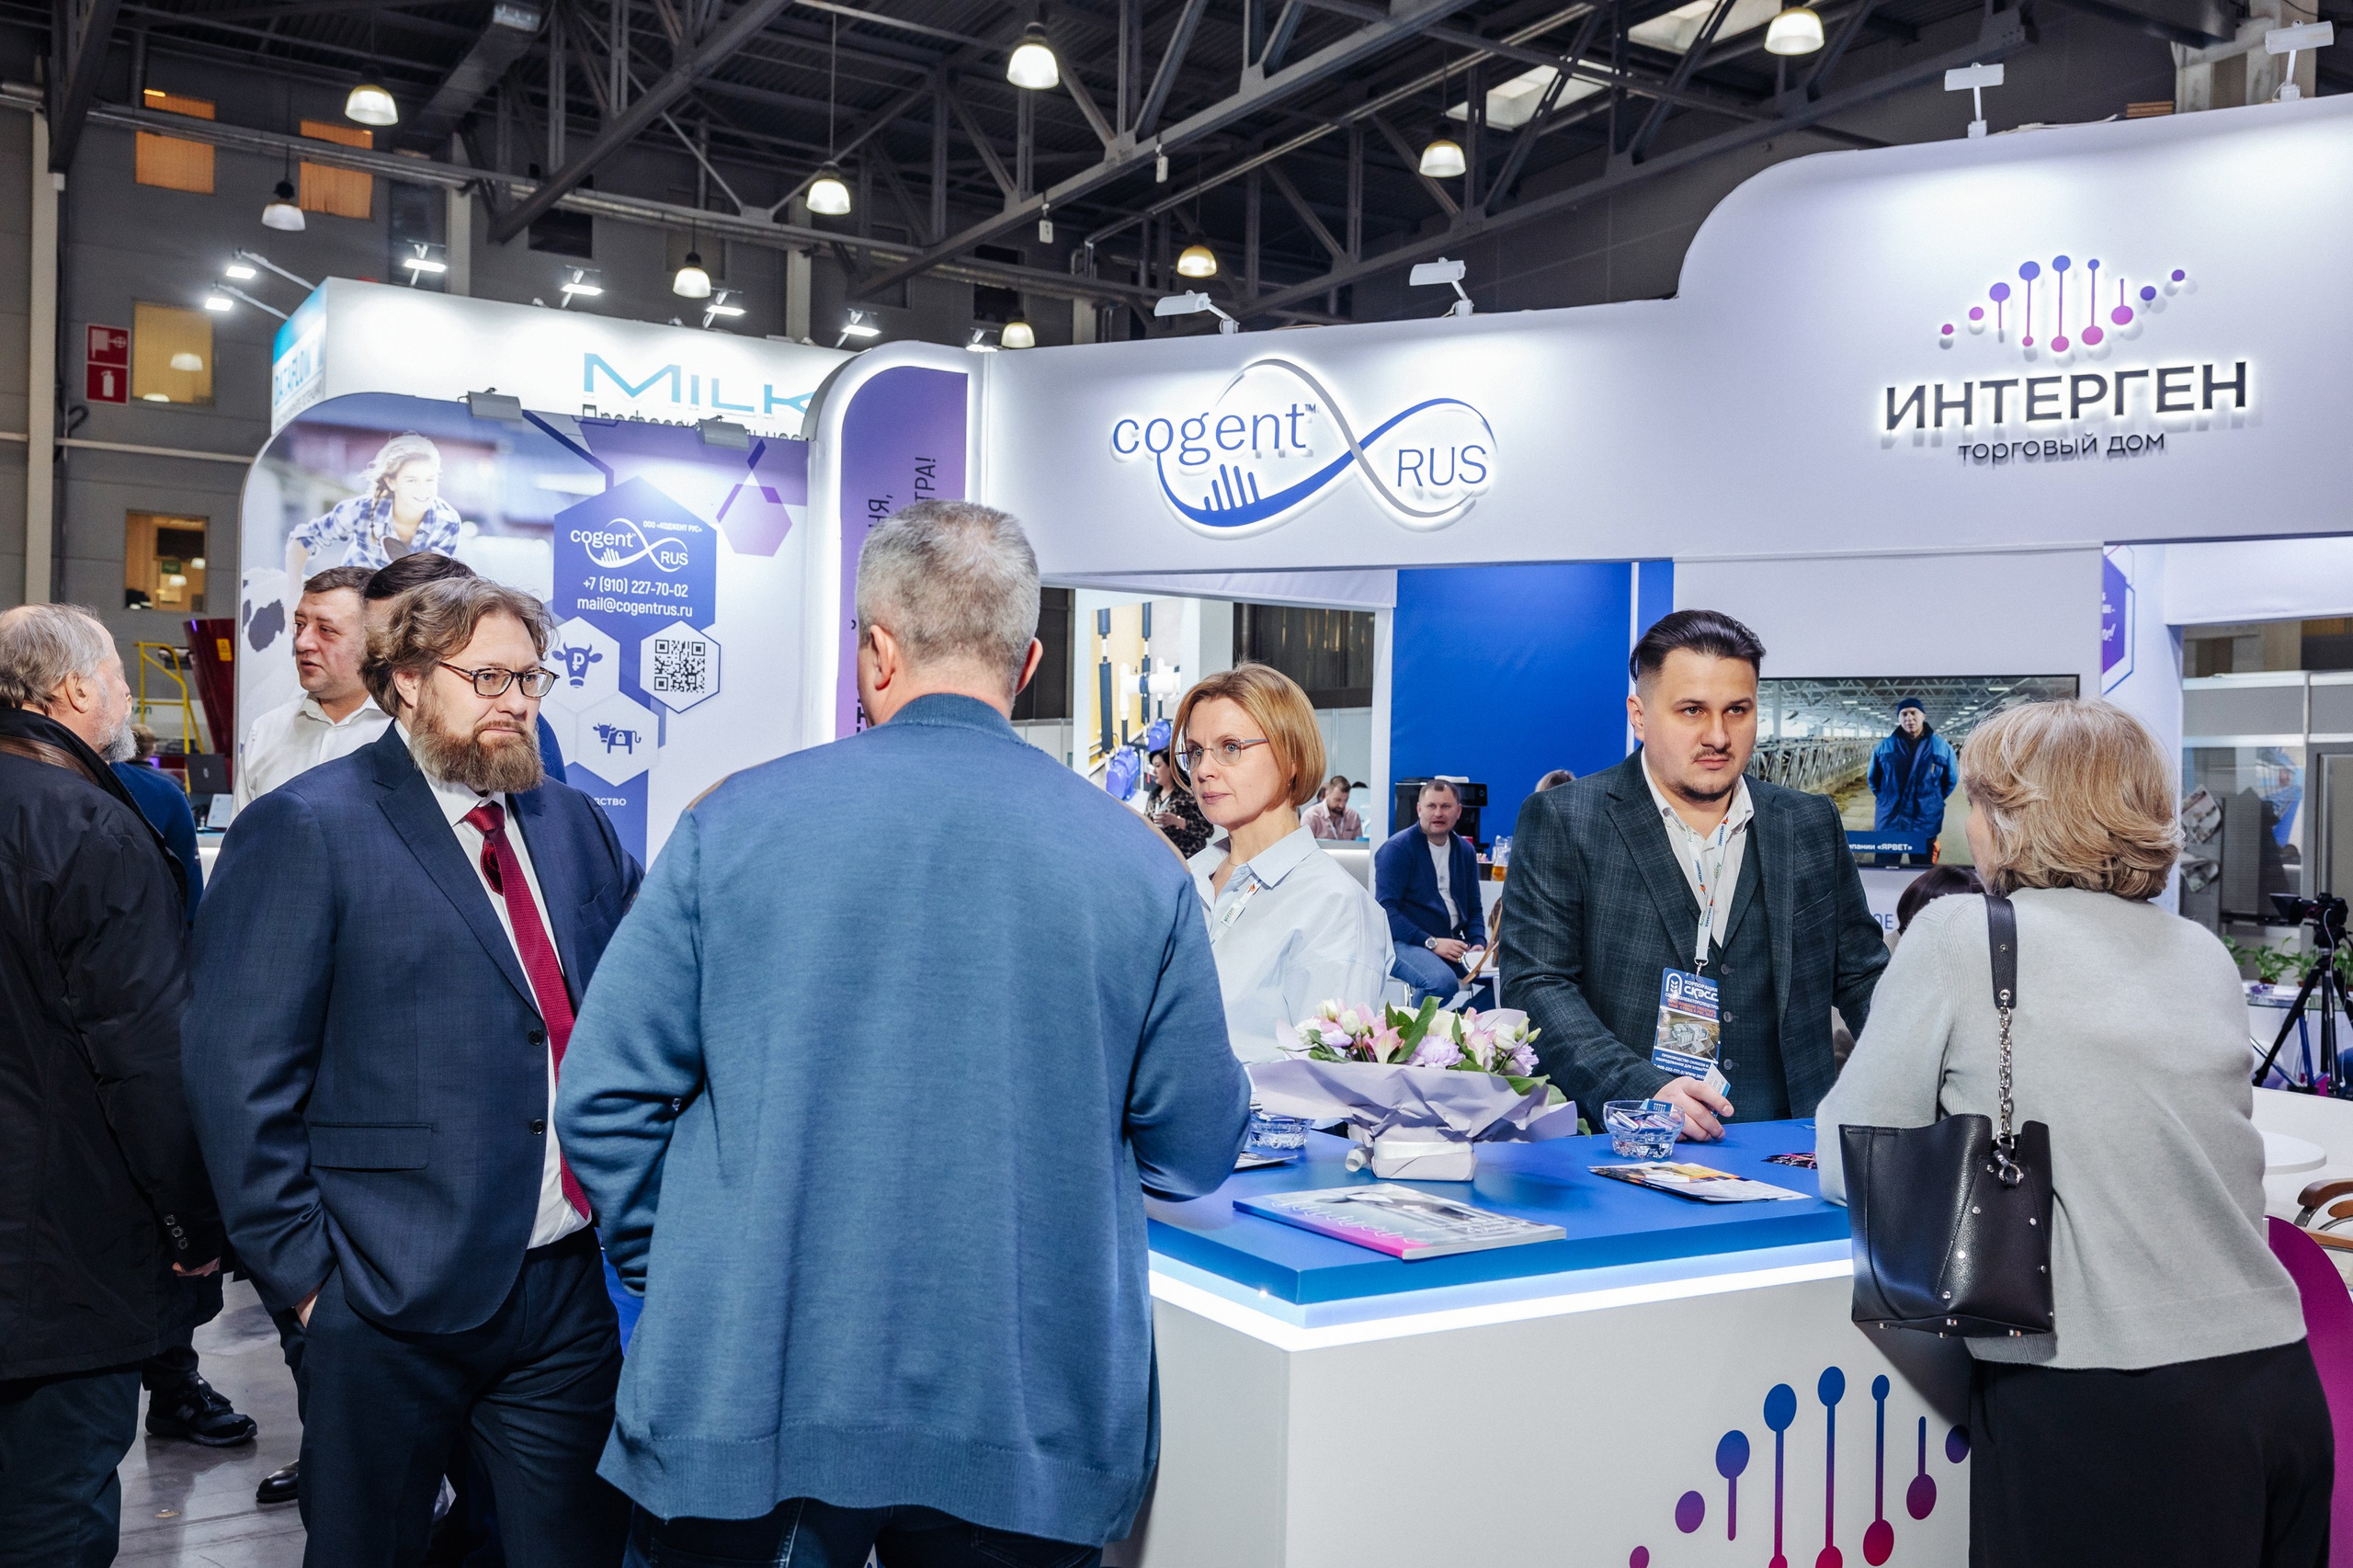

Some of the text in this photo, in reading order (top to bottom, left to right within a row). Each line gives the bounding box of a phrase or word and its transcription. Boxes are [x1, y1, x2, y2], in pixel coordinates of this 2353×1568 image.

[1886, 362, 2246, 430] ИНТЕРГЕН
[1397, 445, 1487, 487] RUS
[915, 456, 936, 503] ТРА!
[643, 520, 656, 528] ООО
[660, 551, 689, 565] RUS
[583, 576, 688, 597] +7 (910) 227-70-02
[577, 597, 693, 617] mail@cogentrus.ru
[1877, 843, 1913, 851] «ЯРВЕТ»
